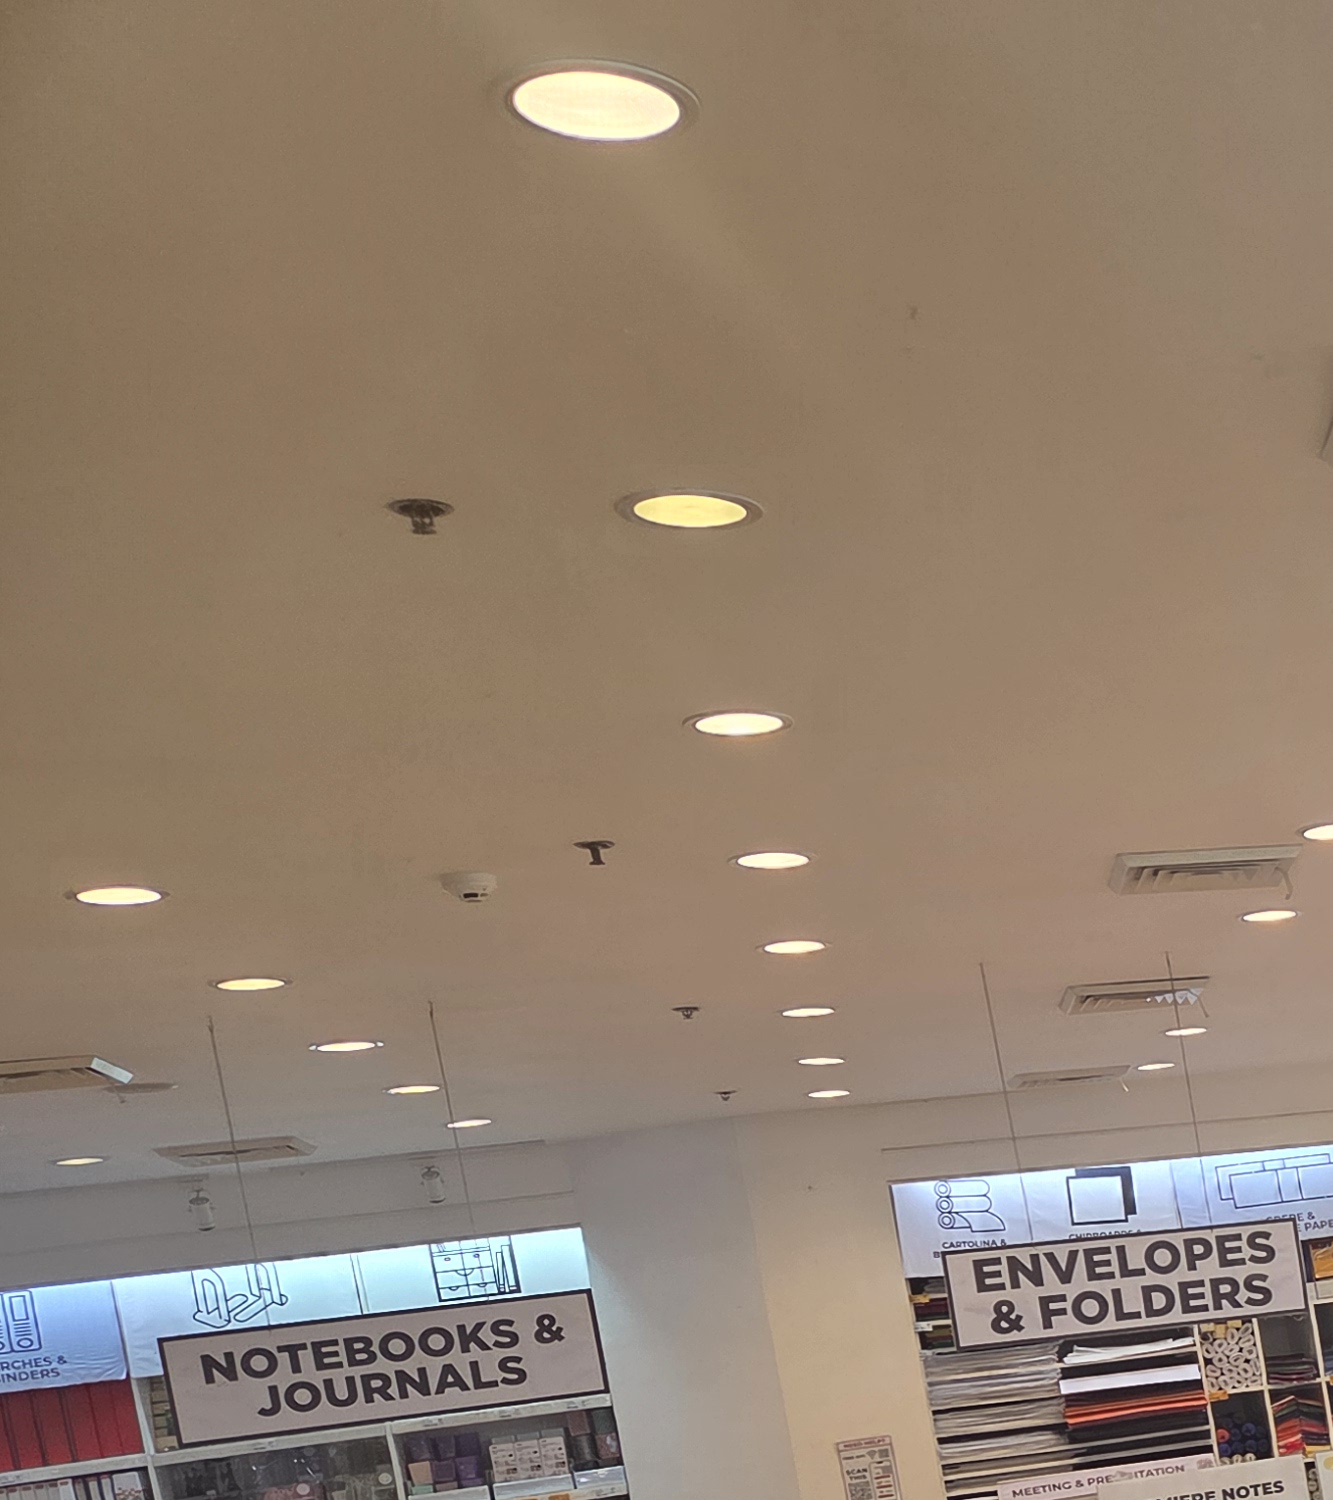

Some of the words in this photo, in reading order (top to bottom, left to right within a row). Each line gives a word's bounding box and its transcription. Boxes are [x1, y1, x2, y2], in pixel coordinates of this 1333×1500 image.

[942, 1239, 997, 1250] CARTOLINA
[972, 1231, 1276, 1294] ENVELOPES
[991, 1299, 1025, 1334] &
[1040, 1273, 1273, 1329] FOLDERS
[200, 1316, 520, 1386] NOTEBOOKS
[533, 1313, 566, 1344] &
[0, 1357, 52, 1372] RCHES
[0, 1368, 60, 1384] INDERS
[258, 1356, 528, 1417] JOURNALS
[1012, 1480, 1072, 1498] MEETING
[1075, 1479, 1084, 1488] &
[1222, 1481, 1285, 1500] NOTES
